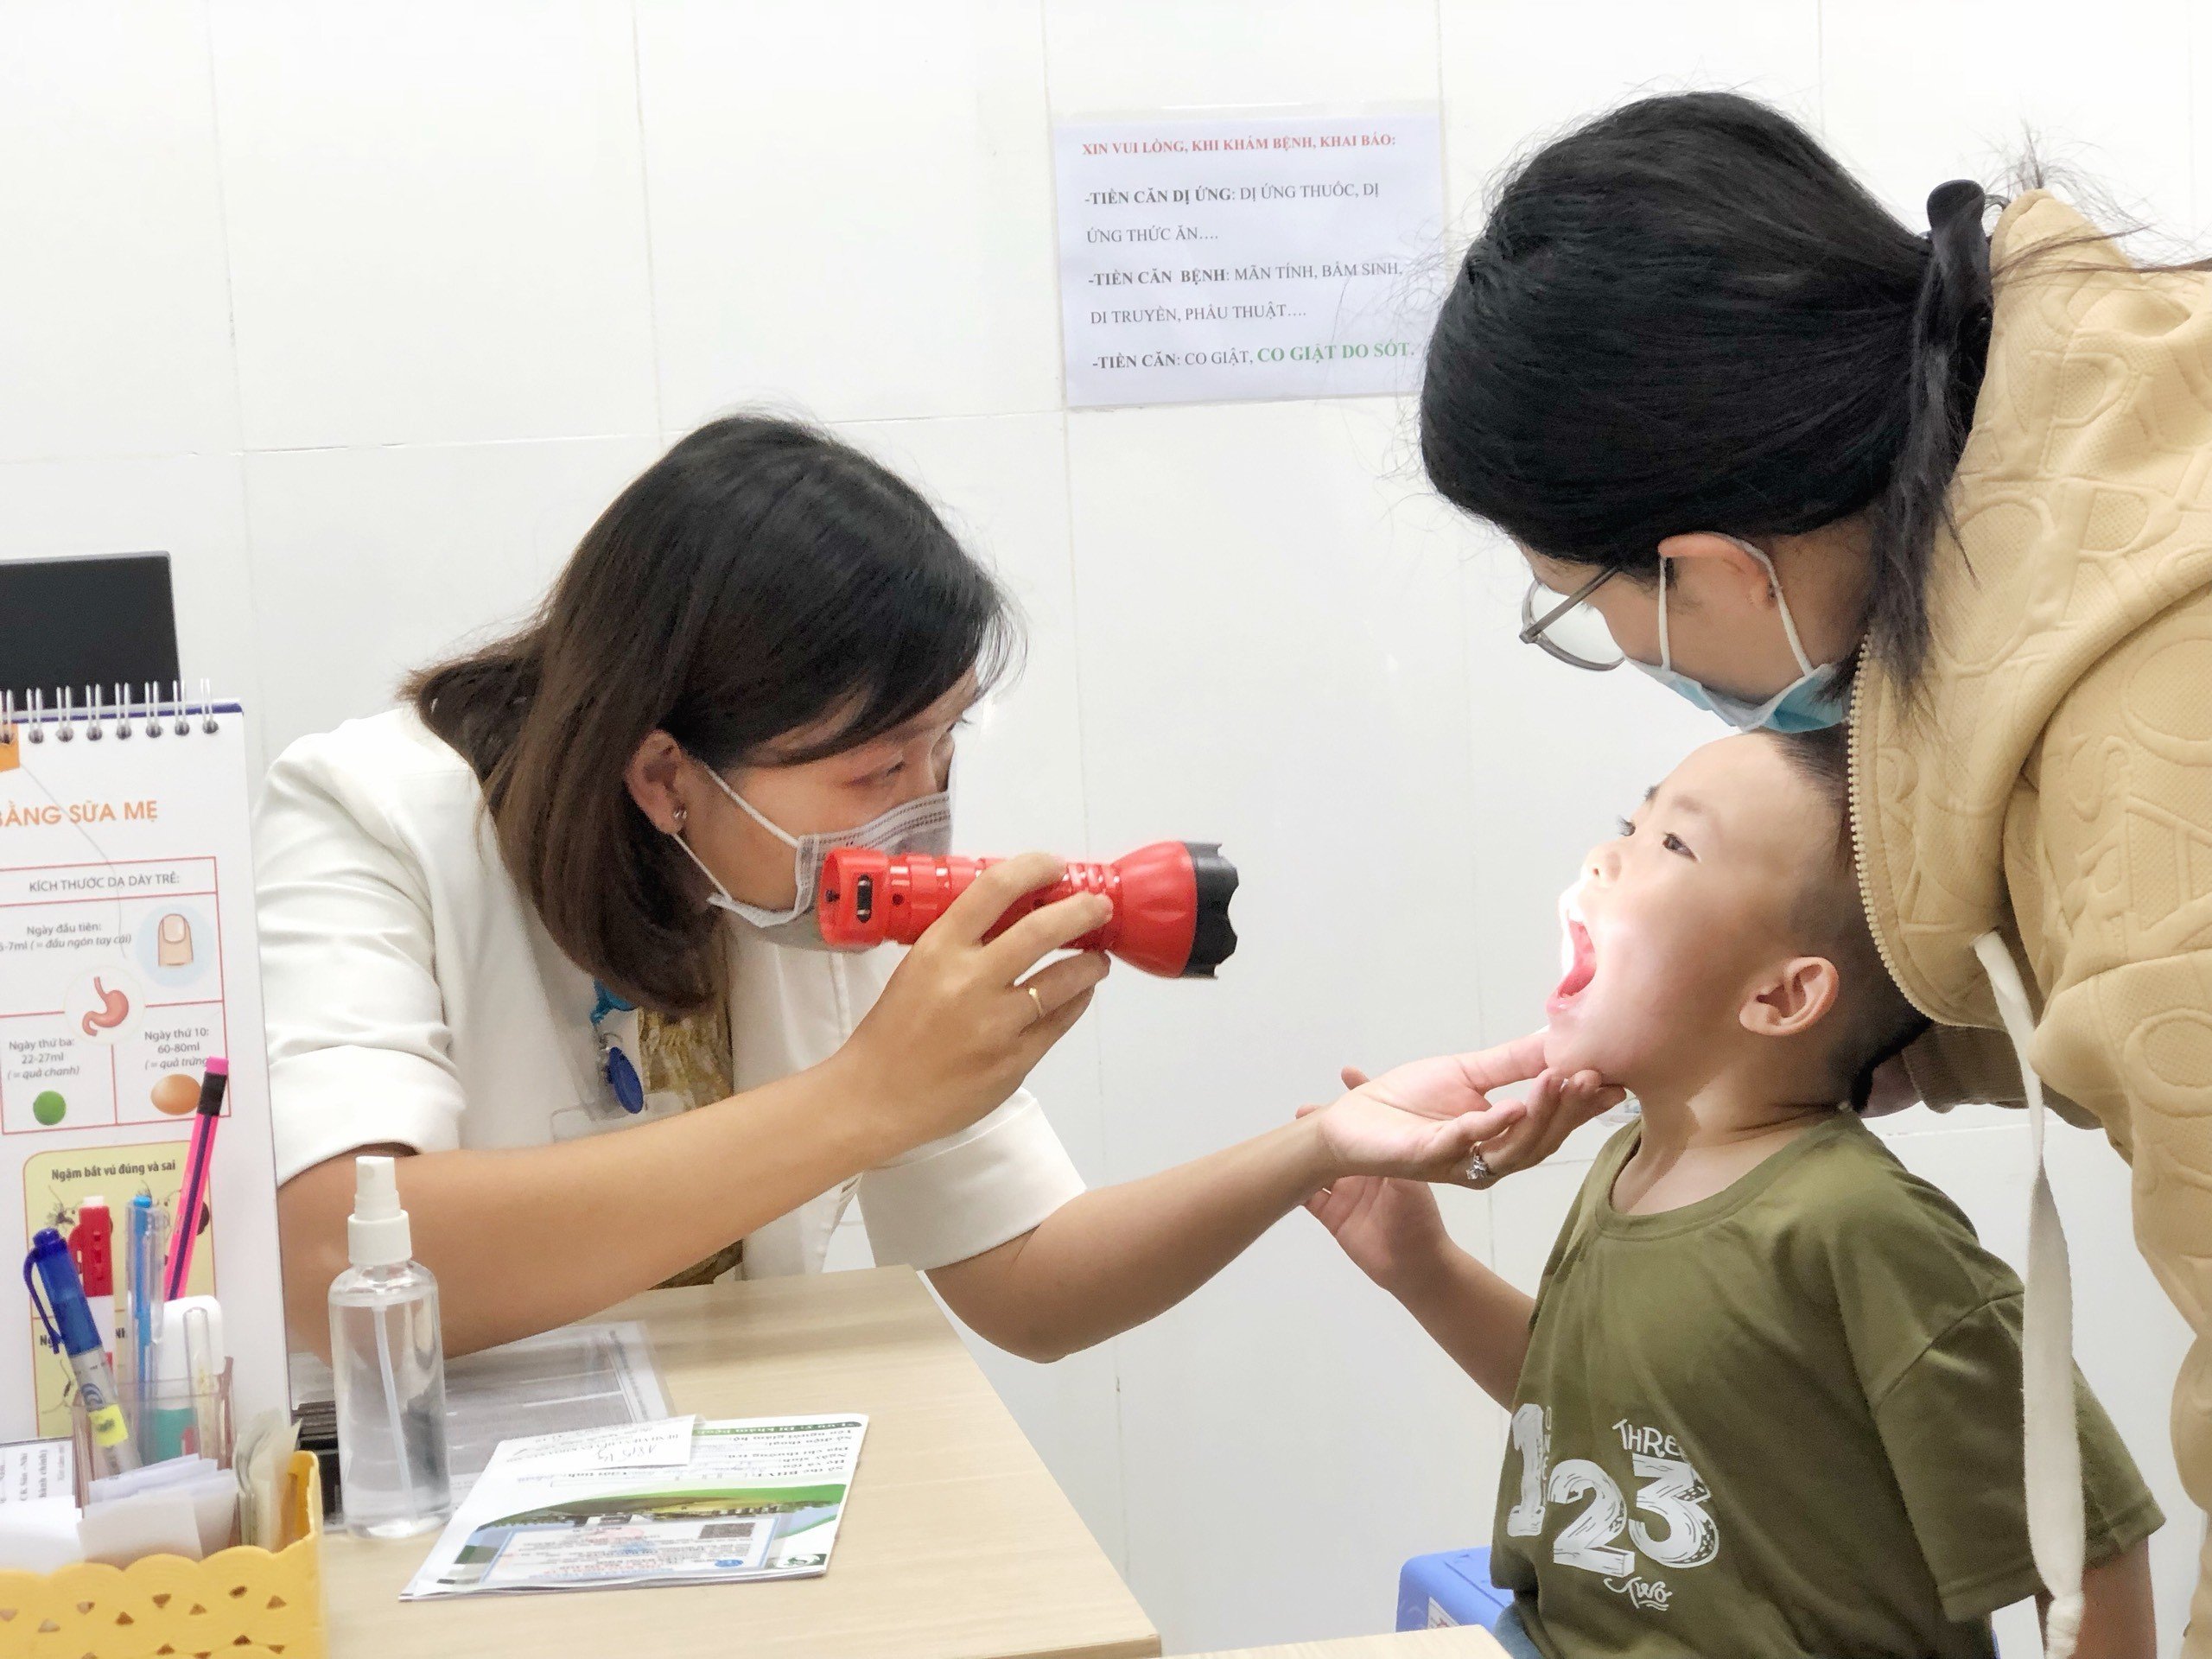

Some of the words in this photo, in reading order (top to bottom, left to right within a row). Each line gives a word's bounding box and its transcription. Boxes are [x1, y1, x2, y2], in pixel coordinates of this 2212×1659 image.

[1082, 143, 1108, 155] XIN
[1112, 142, 1138, 154] VUI
[1142, 138, 1188, 154] LÒNG,
[1192, 140, 1218, 151] KHI
[1224, 135, 1268, 150] KHÁM
[1273, 136, 1317, 151] BỆNH,
[1319, 135, 1357, 148] KHAI
[1361, 131, 1396, 146] BÁO:
[1134, 187, 1167, 204] CĂN
[1173, 189, 1190, 205] DỊ
[1195, 185, 1236, 201] ỨNG:
[1240, 187, 1256, 202] DỊ
[1261, 182, 1296, 200] ỨNG
[1300, 181, 1359, 198] THUỐC,
[1363, 182, 1379, 198] DỊ
[1086, 227, 1122, 243] ỨNG
[1126, 225, 1171, 242] THỨC
[1138, 268, 1172, 284] CĂN
[1181, 268, 1230, 286] BỆNH:
[1275, 263, 1318, 279] TÍNH,
[1090, 311, 1107, 324] DI
[1141, 351, 1181, 367] CĂN:
[1185, 353, 1207, 365] CO
[1211, 347, 1254, 366] GIẬT,
[1257, 347, 1285, 362] CO
[1290, 343, 1337, 364] GIẬT
[1342, 344, 1369, 359] DO
[0, 799, 62, 827] ẰNG
[69, 800, 117, 823] SỮA
[124, 801, 158, 823] MẸ
[29, 878, 58, 893] KÍCH
[129, 872, 151, 887] DÀY
[27, 925, 53, 937] Ngày
[9, 1039, 35, 1051] Ngày
[144, 1031, 171, 1042] Ngày
[157, 1042, 200, 1054] 60-80ml
[21, 1052, 64, 1065] 22-27ml
[52, 1168, 82, 1182] Ngậm
[118, 1161, 145, 1177] đúng
[147, 1161, 159, 1172] và
[162, 1160, 175, 1170] sai
